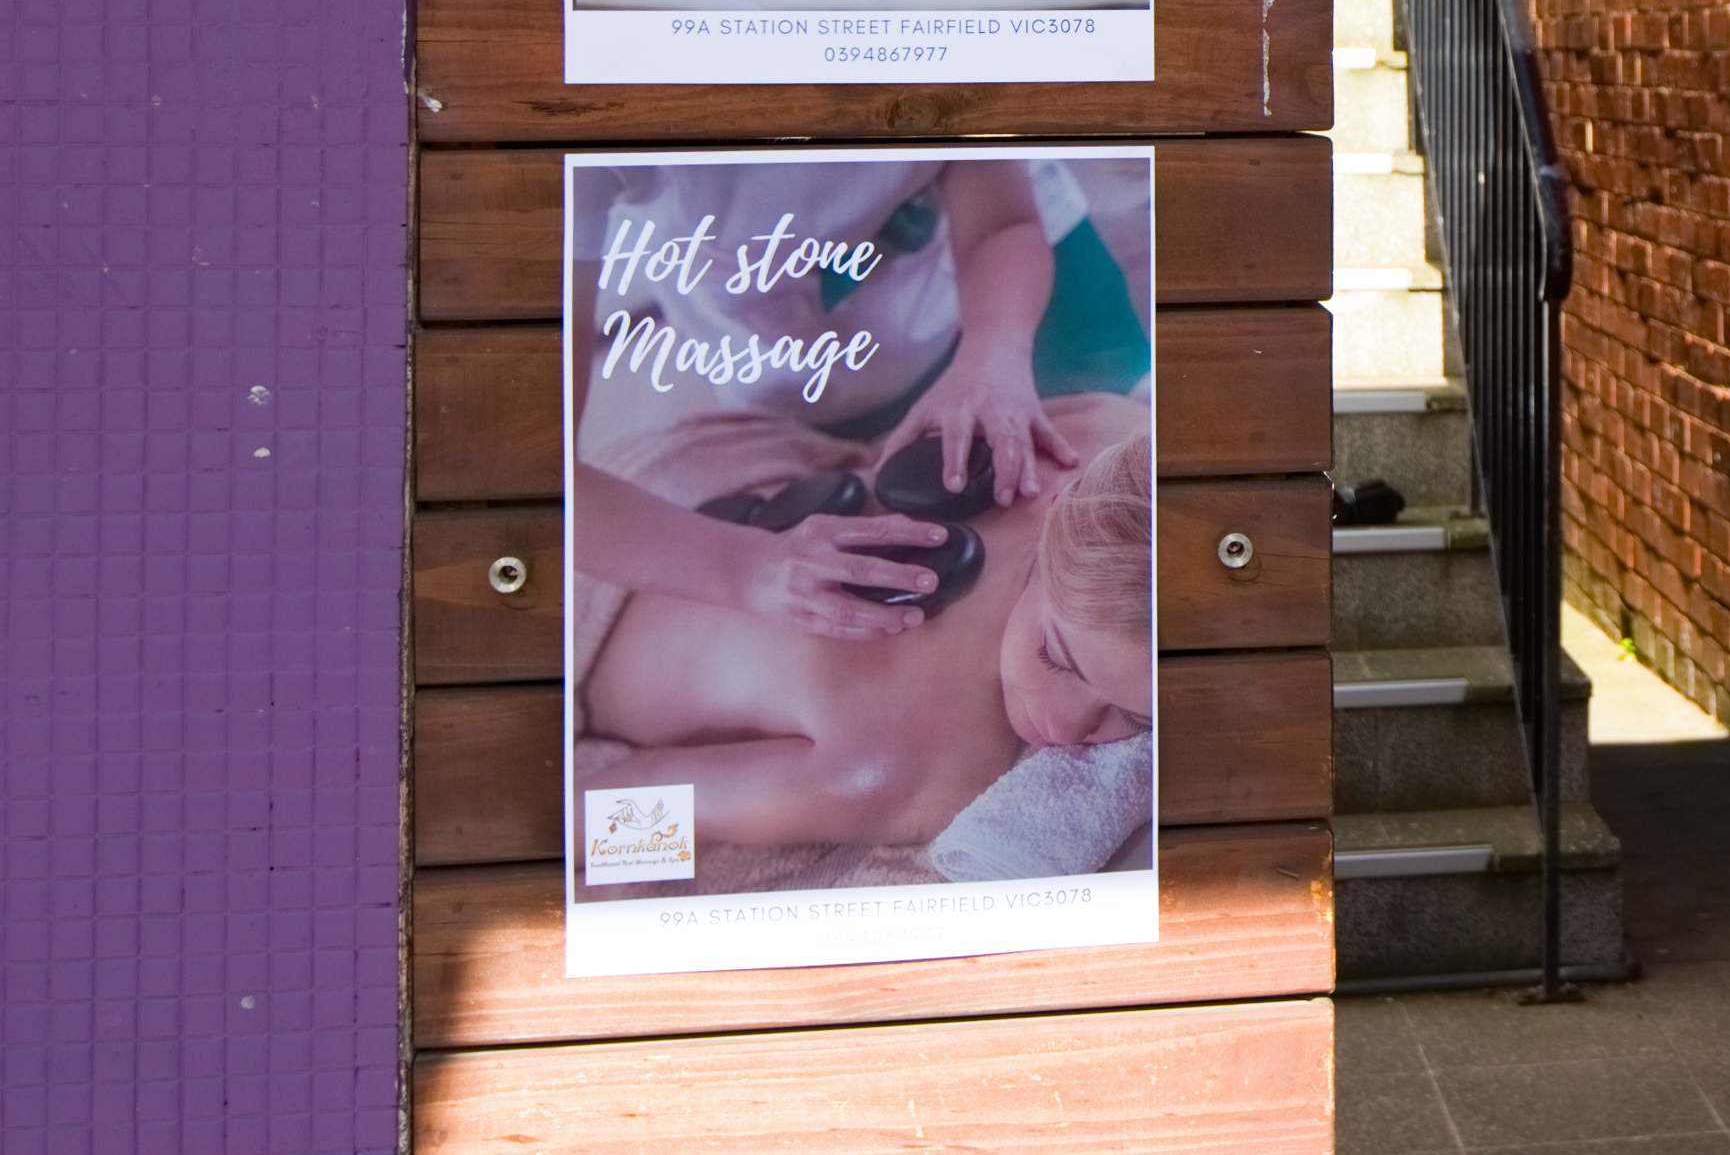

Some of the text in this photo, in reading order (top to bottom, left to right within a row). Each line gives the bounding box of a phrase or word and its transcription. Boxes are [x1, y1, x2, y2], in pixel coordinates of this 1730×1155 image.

[671, 18, 1095, 35] 99A STATION STREET FAIRFIELD VIC3078
[824, 46, 948, 62] 0394867977
[598, 213, 882, 295] Hot stone
[602, 309, 880, 403] Massage
[591, 824, 689, 856] Kornkanok
[660, 888, 1092, 927] 99A STATION STREET FAIRFIELD VIC3078
